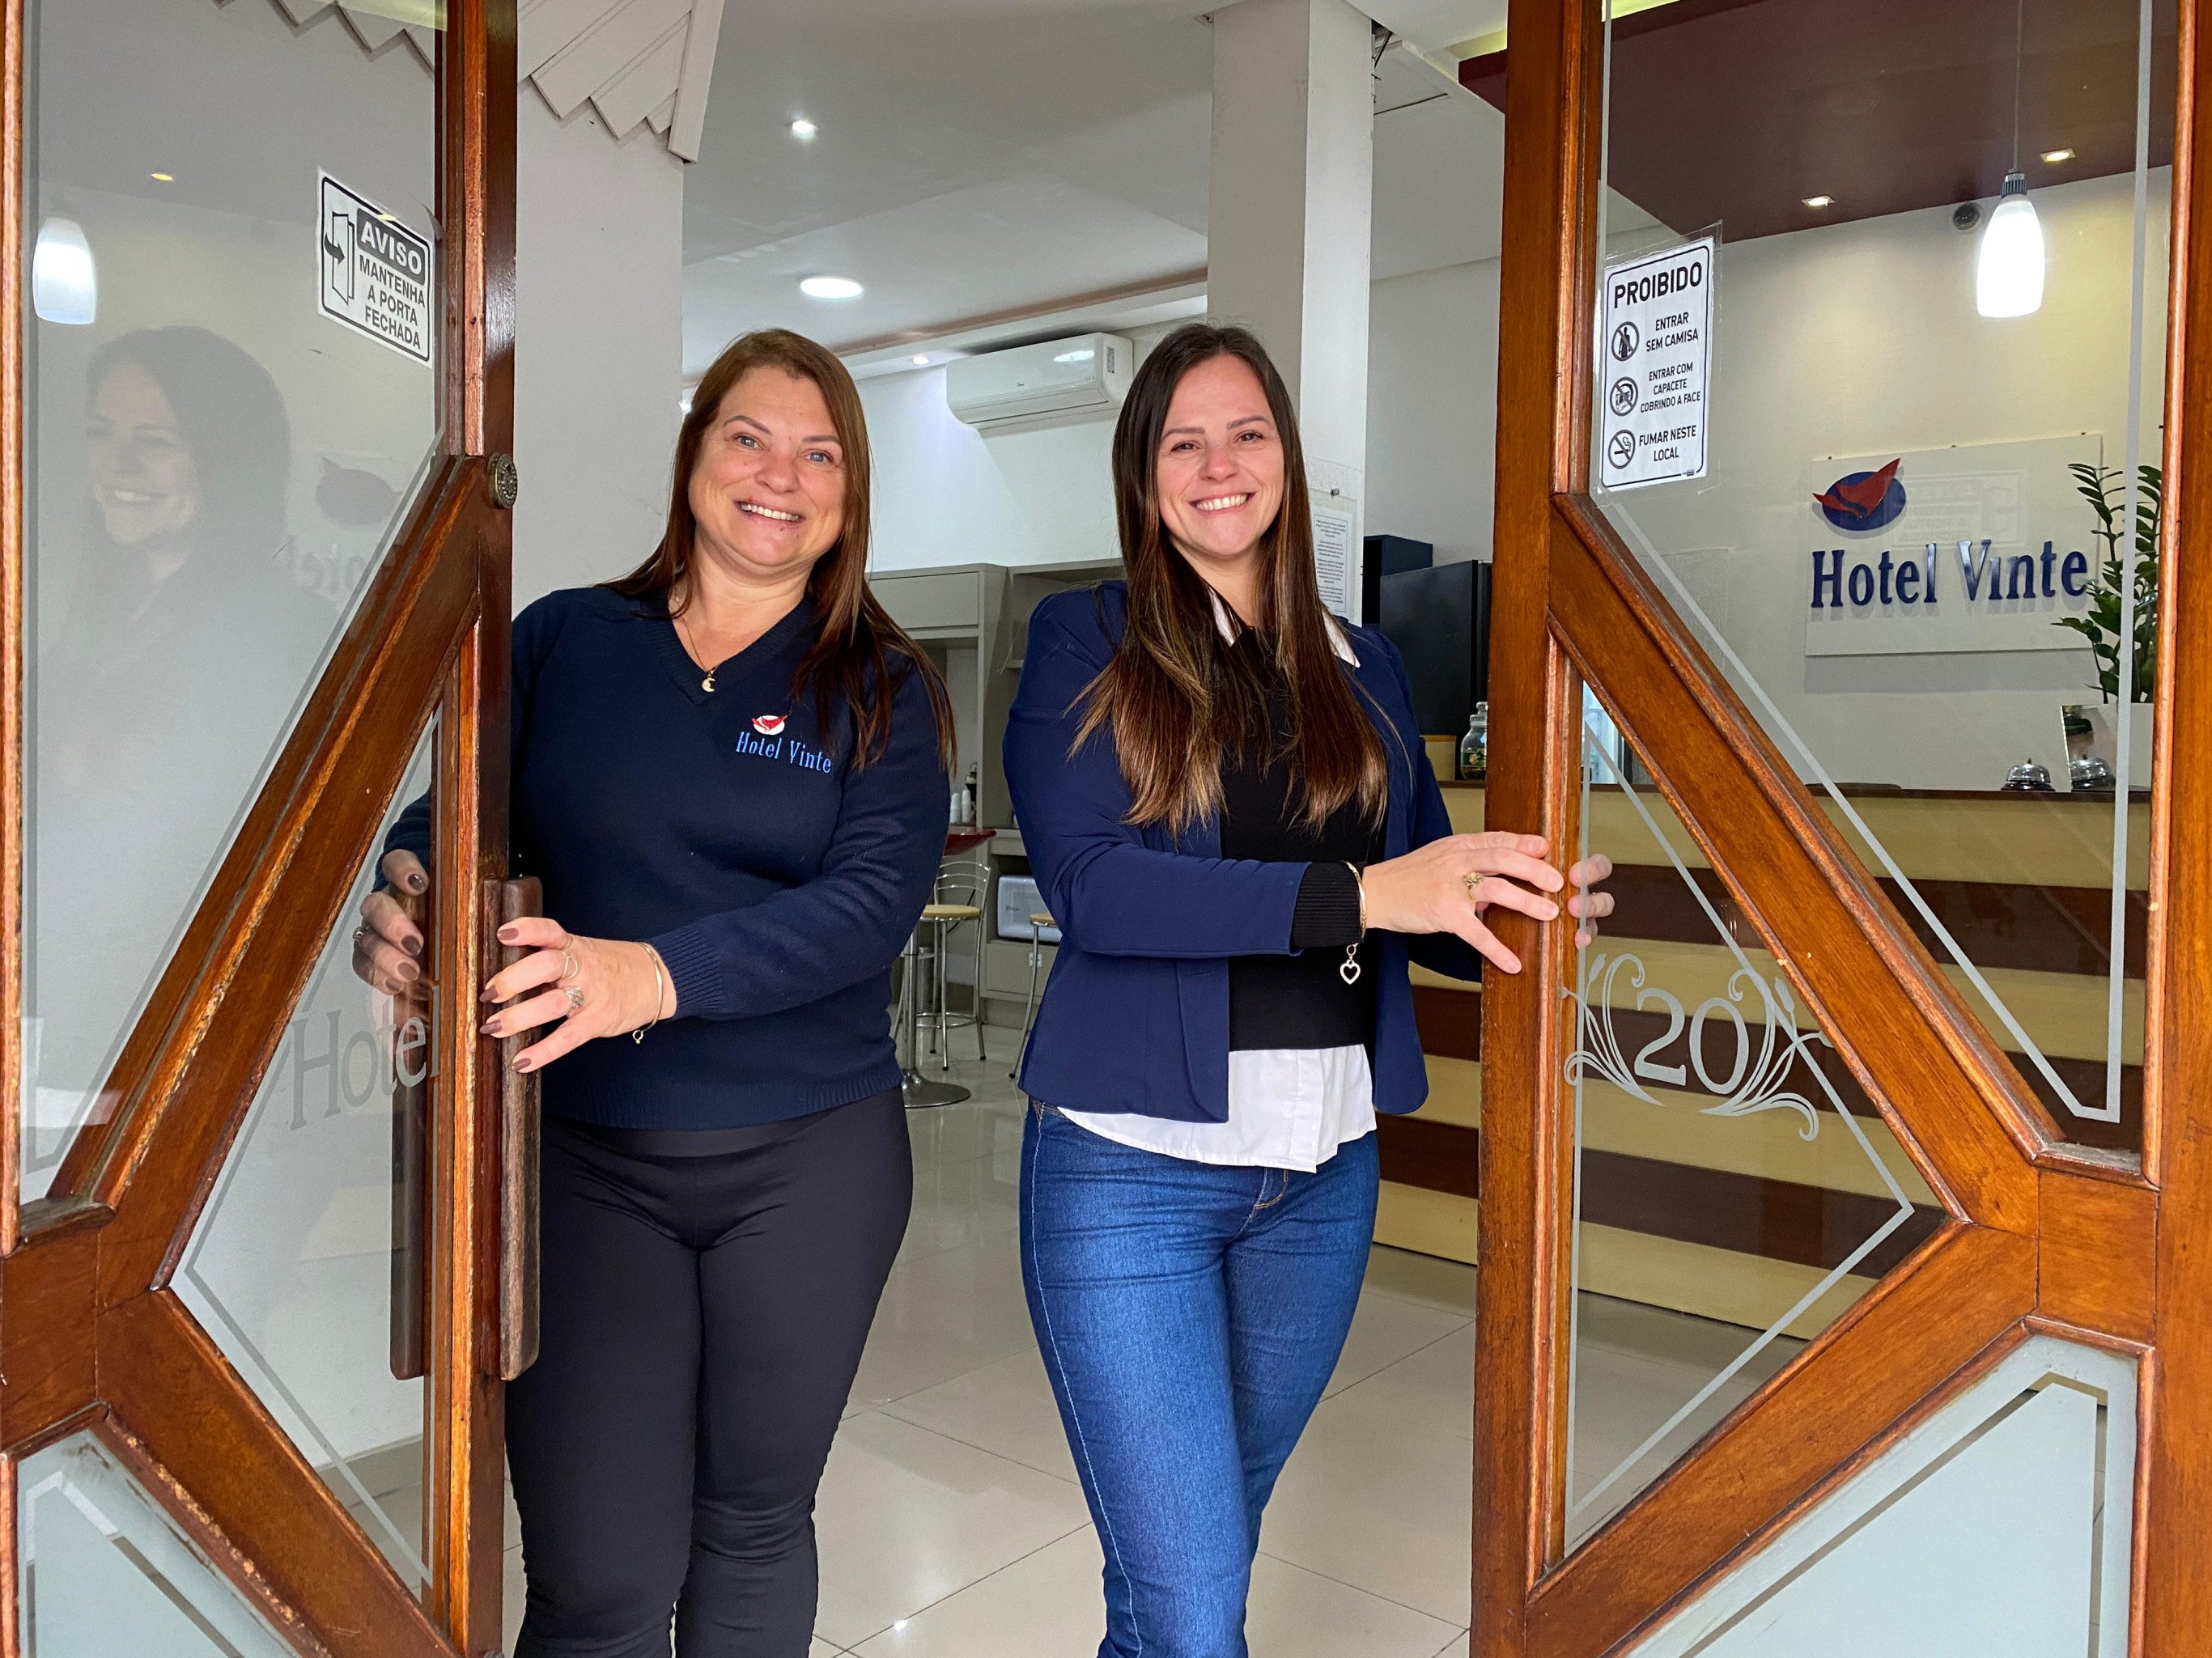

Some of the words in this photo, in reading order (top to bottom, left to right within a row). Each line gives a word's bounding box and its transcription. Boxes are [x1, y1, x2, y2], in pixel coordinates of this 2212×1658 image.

[360, 220, 422, 275] AVISO
[359, 254, 425, 307] MANTENHA
[1614, 261, 1702, 309] PROIBIDO
[367, 285, 376, 303] A
[380, 290, 418, 326] PORTA
[1655, 312, 1689, 332] ENTRAR
[365, 305, 421, 350] FECHADA
[1645, 339, 1663, 352] SEM
[1665, 329, 1699, 350] CAMISA
[1649, 366, 1675, 382] ENTRAR
[1676, 362, 1693, 375] COM
[1654, 378, 1688, 395] CAPACETE
[1640, 396, 1676, 413] COBRINDO
[1677, 395, 1683, 405] A
[1683, 391, 1701, 404] FACE
[1638, 430, 1669, 447] FUMAR
[1671, 425, 1696, 442] NESTE
[1653, 447, 1679, 462] LOCAL
[1811, 543, 1938, 608] Hotel
[1957, 539, 2088, 600] Vinte
[735, 731, 783, 759] Hotel
[790, 740, 832, 774] Vinte
[1633, 987, 1750, 1095] 20
